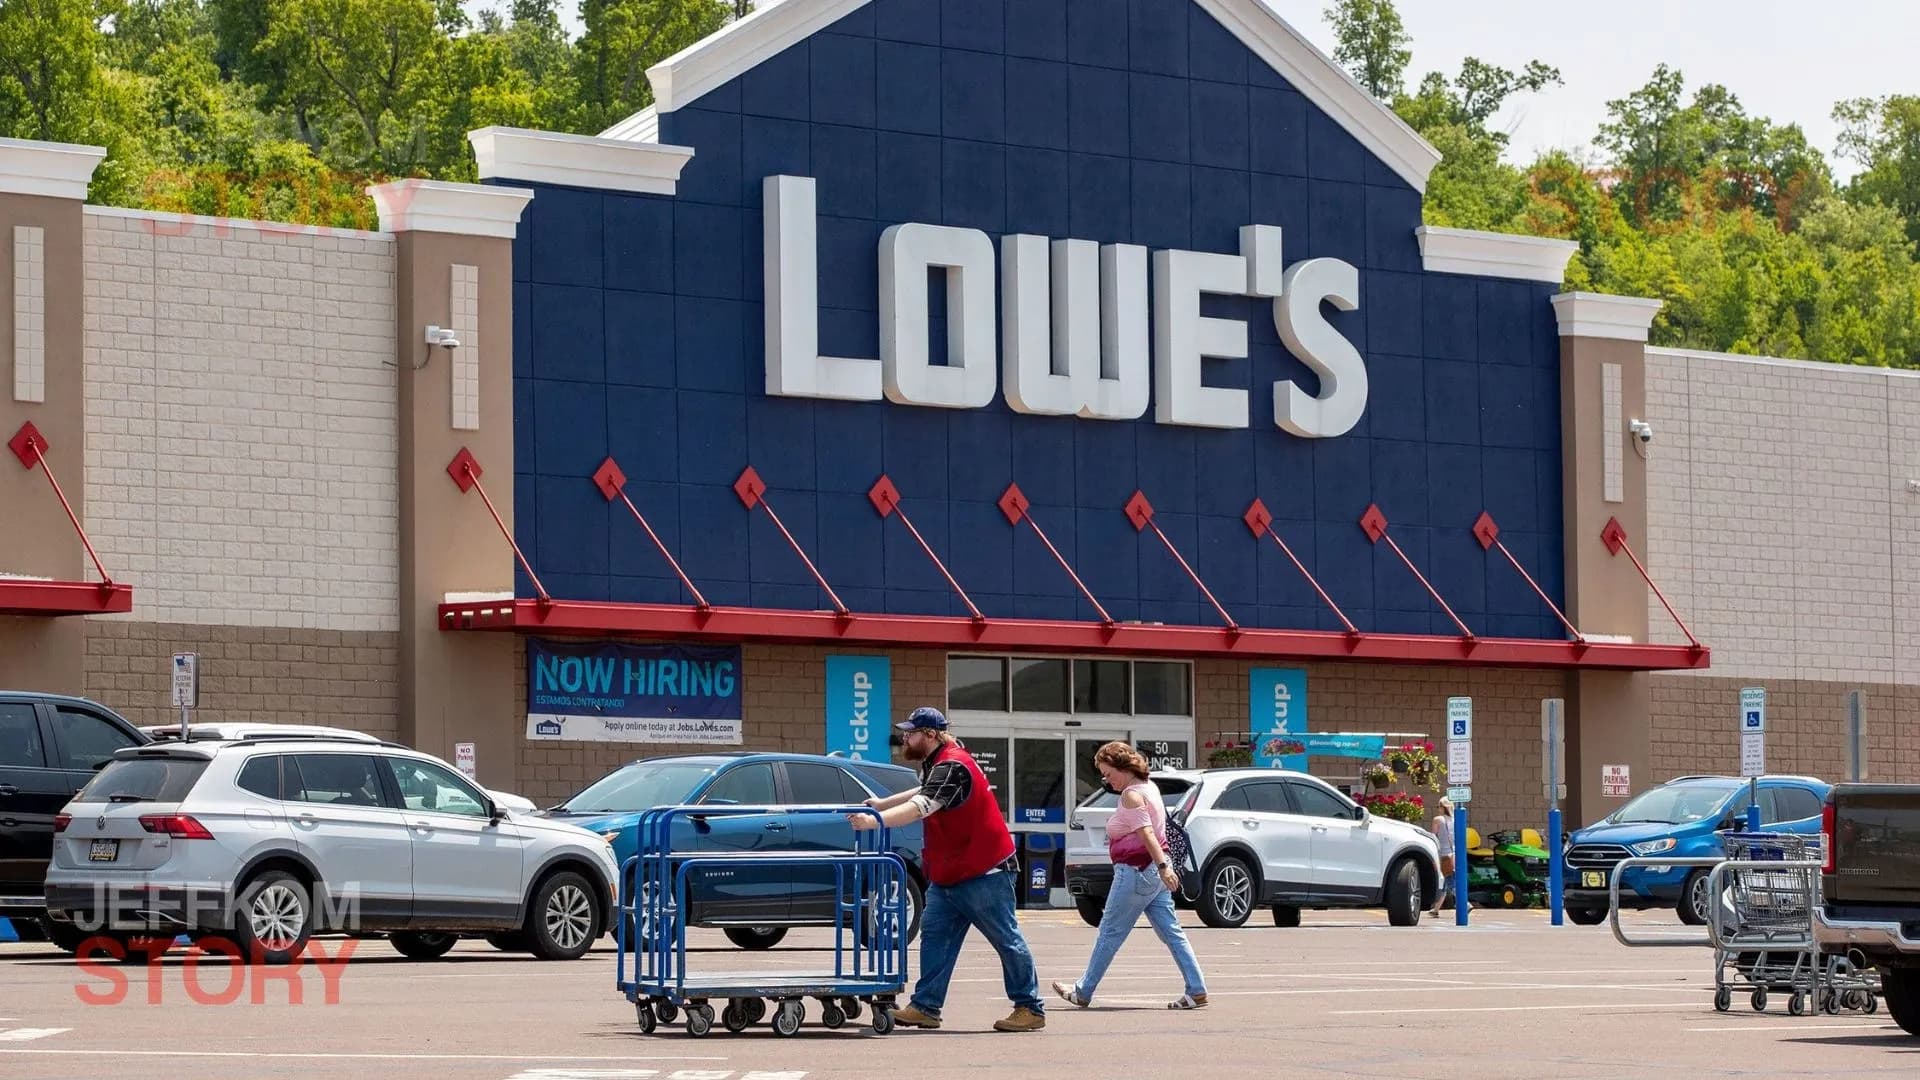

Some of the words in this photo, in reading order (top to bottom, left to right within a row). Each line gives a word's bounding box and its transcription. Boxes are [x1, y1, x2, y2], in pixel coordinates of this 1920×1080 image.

[763, 174, 1368, 439] LOWE'S
[535, 655, 615, 694] NOW
[624, 658, 735, 698] HIRING
[536, 695, 571, 706] ESTAMOS
[572, 697, 625, 708] CONTRATANDO
[604, 722, 624, 732] Apply
[625, 721, 647, 731] online
[648, 722, 667, 732] today
[669, 723, 675, 731] at
[1155, 742, 1169, 754] 50
[1612, 767, 1620, 775] NO
[1604, 776, 1628, 784] PARKING
[1604, 786, 1614, 794] FIRE
[1616, 786, 1629, 794] LANE
[1026, 809, 1046, 817] ENTER
[1032, 877, 1046, 885] PRO
